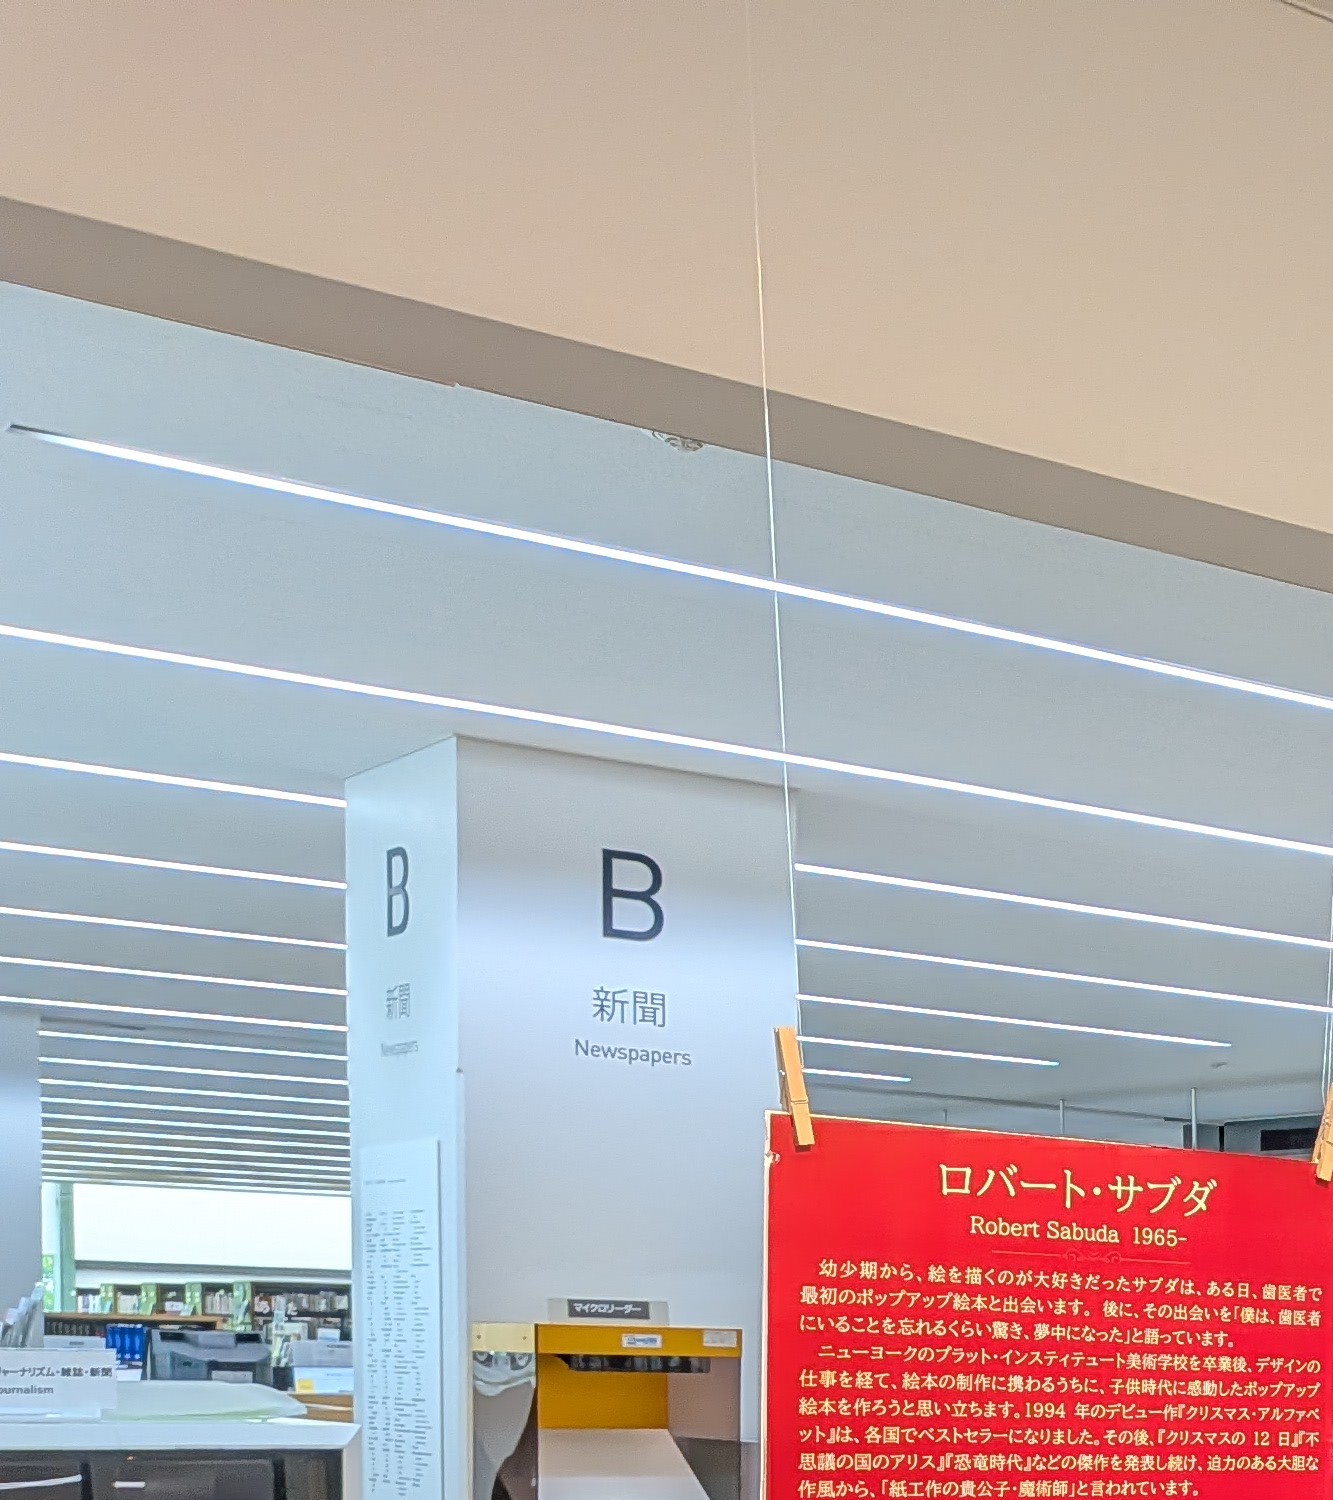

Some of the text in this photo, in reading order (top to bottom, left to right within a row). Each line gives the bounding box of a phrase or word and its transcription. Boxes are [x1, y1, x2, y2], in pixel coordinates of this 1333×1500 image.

[386, 846, 410, 937] B
[602, 848, 664, 941] B
[592, 985, 666, 1027] 新聞
[574, 1039, 692, 1067] Newspapers
[939, 1163, 1218, 1217] ロバート・サブダ
[970, 1216, 1187, 1246] Robert Sabuda 1965-
[819, 1259, 1322, 1302] 幼少期から、絵を描くのが大好きだったサブダは、ある日、歯医者で
[573, 1303, 641, 1314] マイクロリーダー
[0, 1366, 113, 1378] ャーナリズム・雑誌・新聞
[0, 1385, 54, 1395] ournalism
[798, 1480, 1201, 1498] 作風から、「紙工作の貴公子・魔術師」と言われています。
